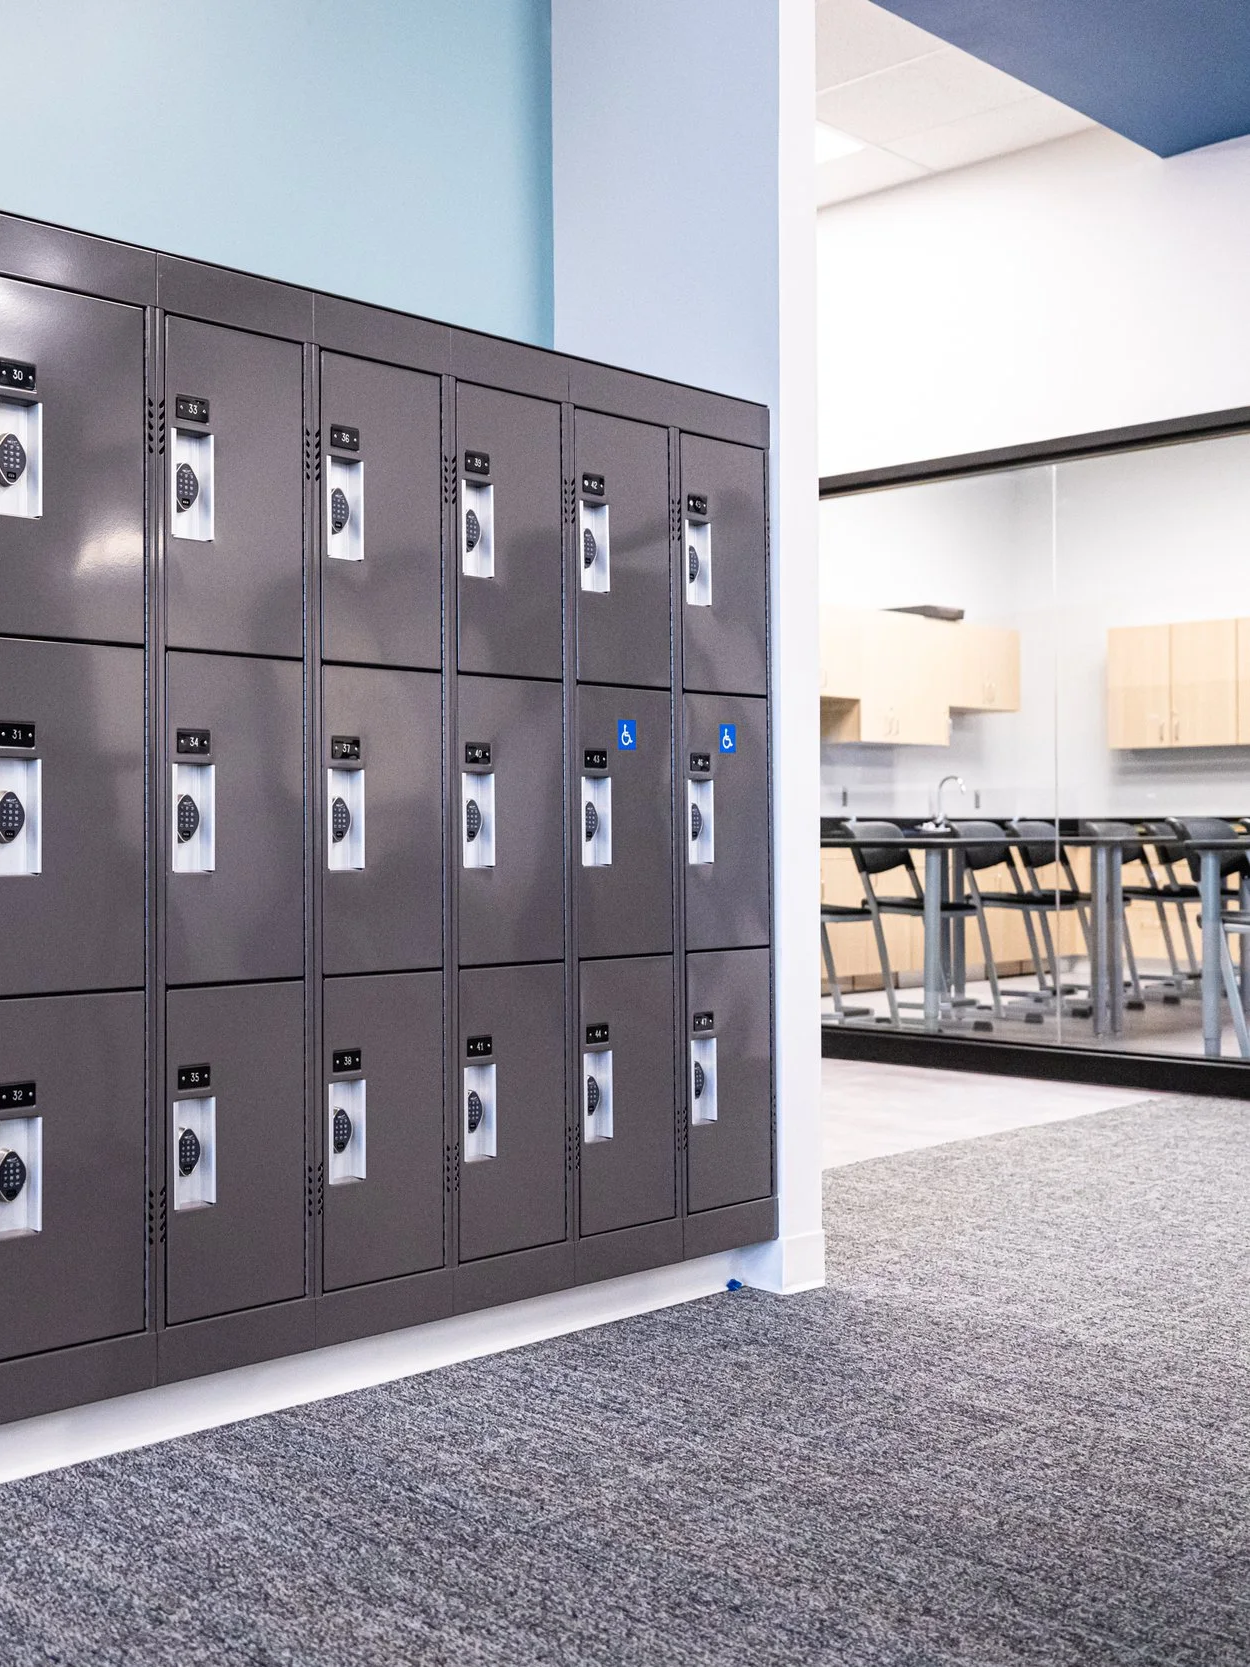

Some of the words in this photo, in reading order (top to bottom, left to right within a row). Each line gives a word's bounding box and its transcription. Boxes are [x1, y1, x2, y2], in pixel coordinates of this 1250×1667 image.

[12, 369, 23, 381] 30
[188, 403, 198, 414] 33
[341, 433, 350, 443] 36
[474, 458, 482, 467] 39
[12, 729, 22, 740] 31
[189, 737, 199, 747] 34
[342, 744, 350, 753] 37
[475, 749, 482, 758] 40
[476, 1042, 484, 1051] 41
[343, 1056, 352, 1066] 38
[190, 1073, 199, 1082] 35
[12, 1090, 23, 1101] 32
